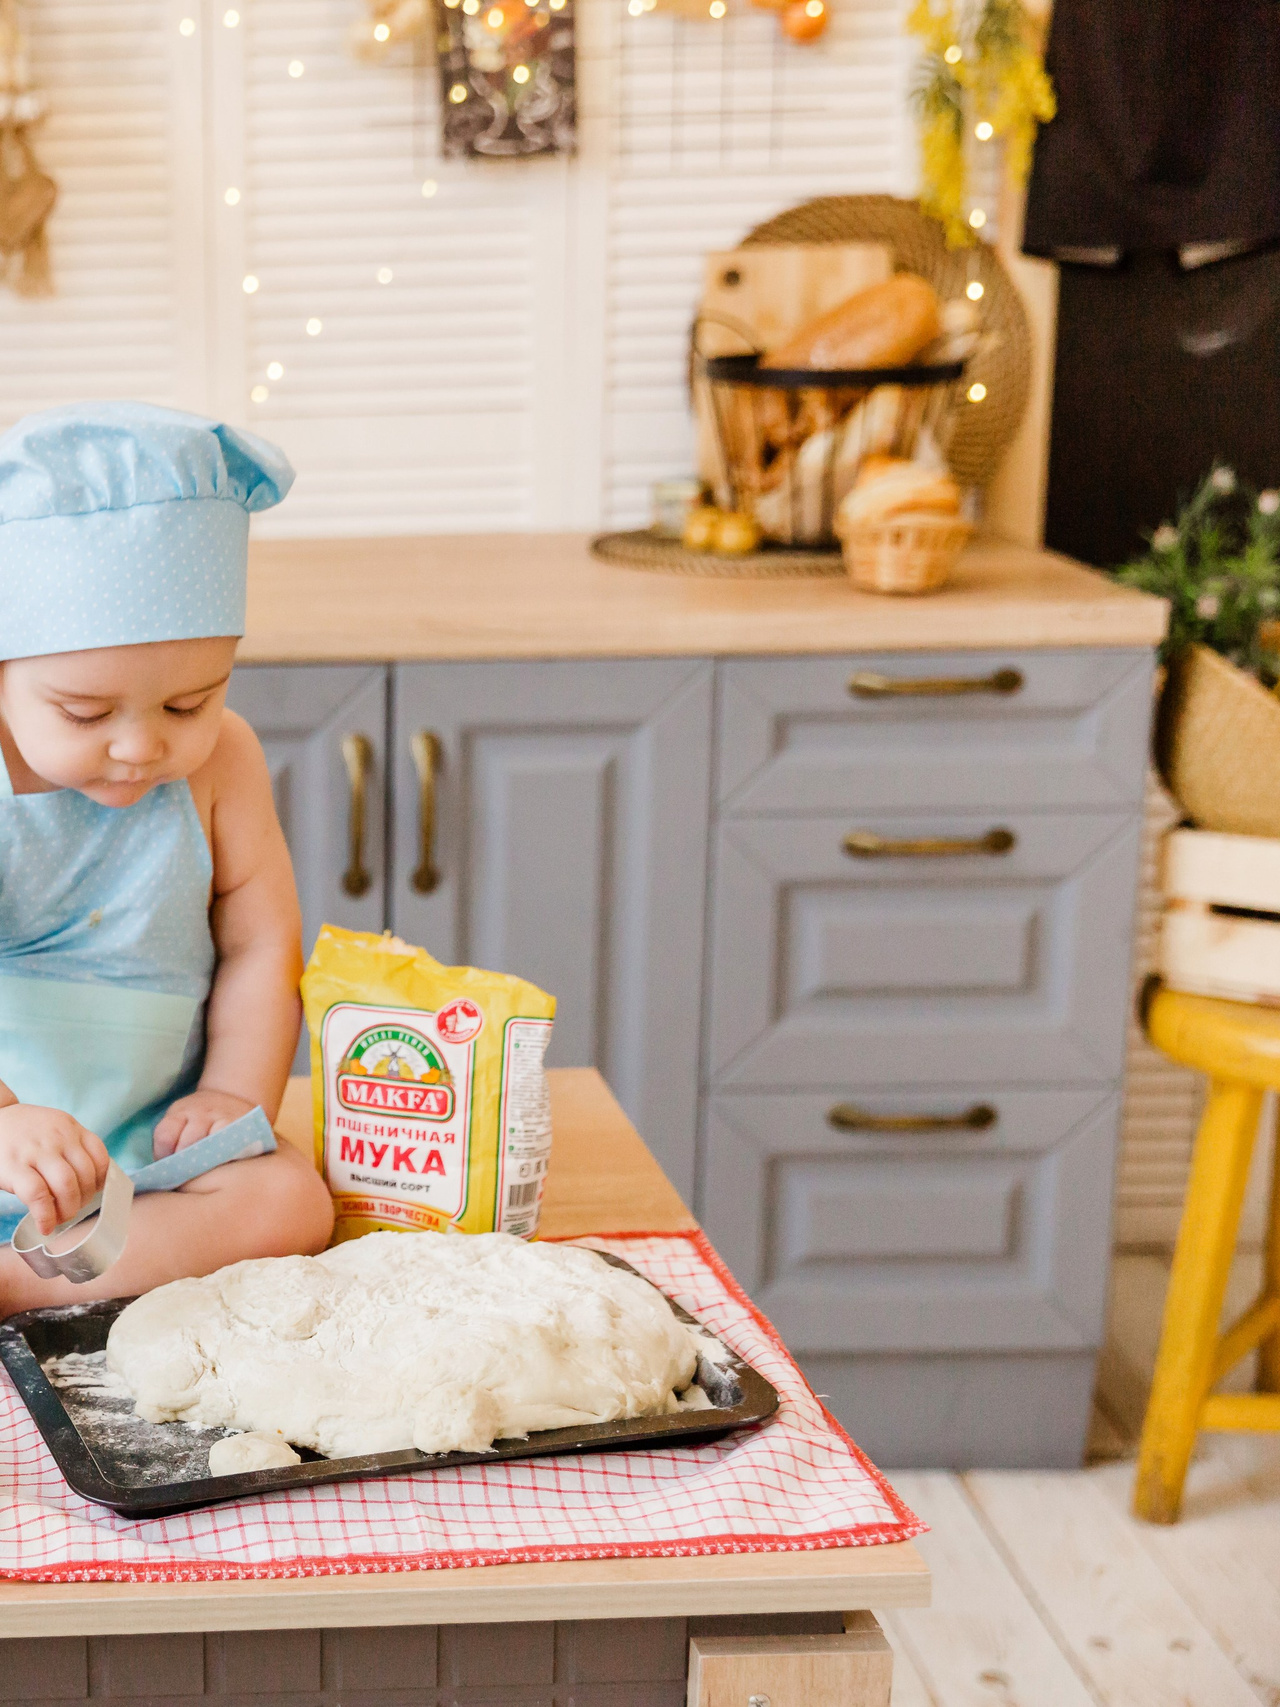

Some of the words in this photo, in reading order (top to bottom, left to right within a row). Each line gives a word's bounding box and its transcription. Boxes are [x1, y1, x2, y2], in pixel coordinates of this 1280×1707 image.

[346, 1082, 440, 1113] MAKFA
[336, 1116, 456, 1145] ПШЕНИЧНАЯ
[340, 1135, 447, 1176] МУКА
[350, 1173, 397, 1188] ВЫСШИЙ
[400, 1182, 431, 1193] СОРТ
[379, 1203, 439, 1228] ТВОРЧЕСТВА
